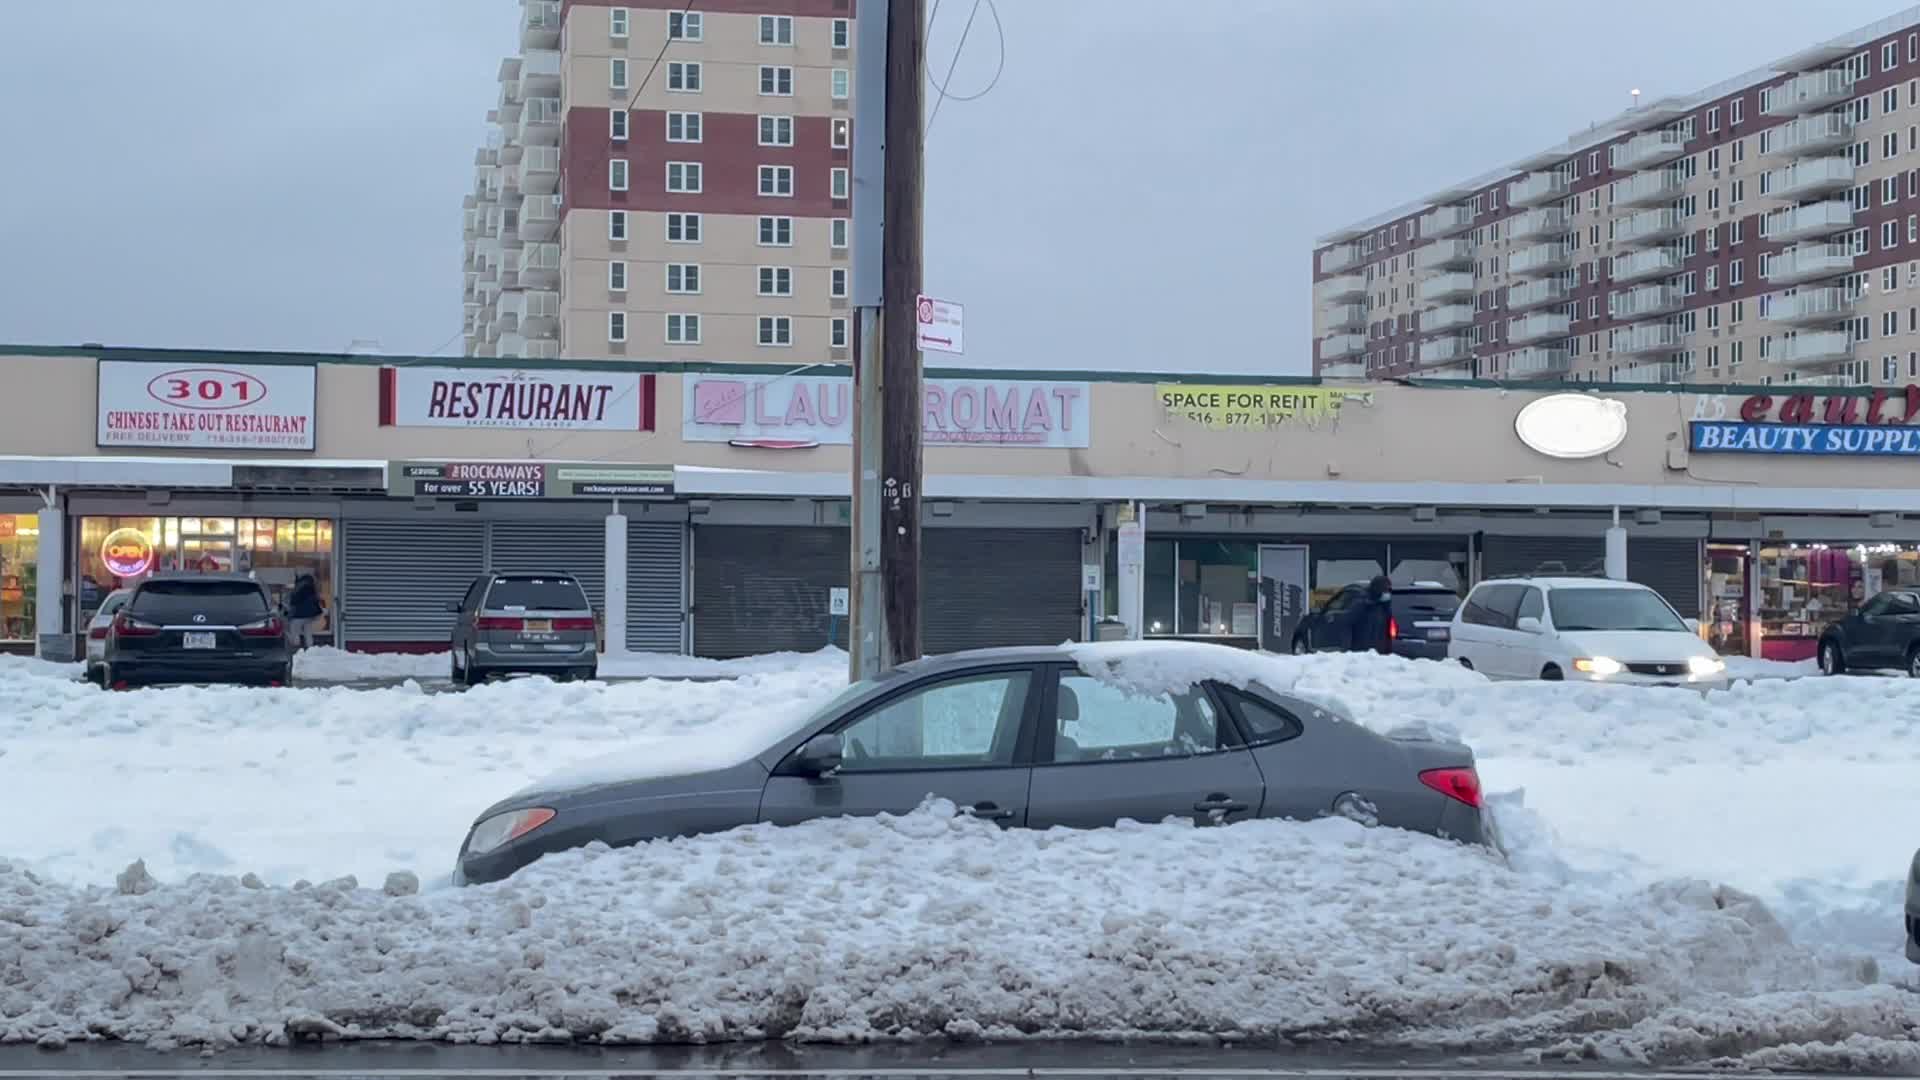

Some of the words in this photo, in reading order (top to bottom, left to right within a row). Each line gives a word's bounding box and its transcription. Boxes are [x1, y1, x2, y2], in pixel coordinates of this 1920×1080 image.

[166, 379, 248, 401] 301
[428, 381, 613, 421] RESTAURANT
[754, 382, 1082, 432] LAUROMAT
[1162, 393, 1220, 408] SPACE
[1227, 394, 1264, 408] FOR
[1270, 394, 1318, 409] RENT
[106, 411, 160, 430] CHINESE
[162, 413, 195, 432] TAKE
[199, 413, 223, 432] OUT
[226, 414, 307, 433] RESTAURANT
[106, 431, 134, 441] FREE
[138, 432, 192, 442] DELIVERY
[1700, 426, 1822, 450] BEAUTY
[461, 465, 542, 480] ROCKAWAYS
[424, 482, 439, 492] for
[440, 484, 462, 493] over
[469, 481, 486, 495] 55
[490, 481, 540, 496] YEARS!
[109, 546, 144, 558] OPEN
